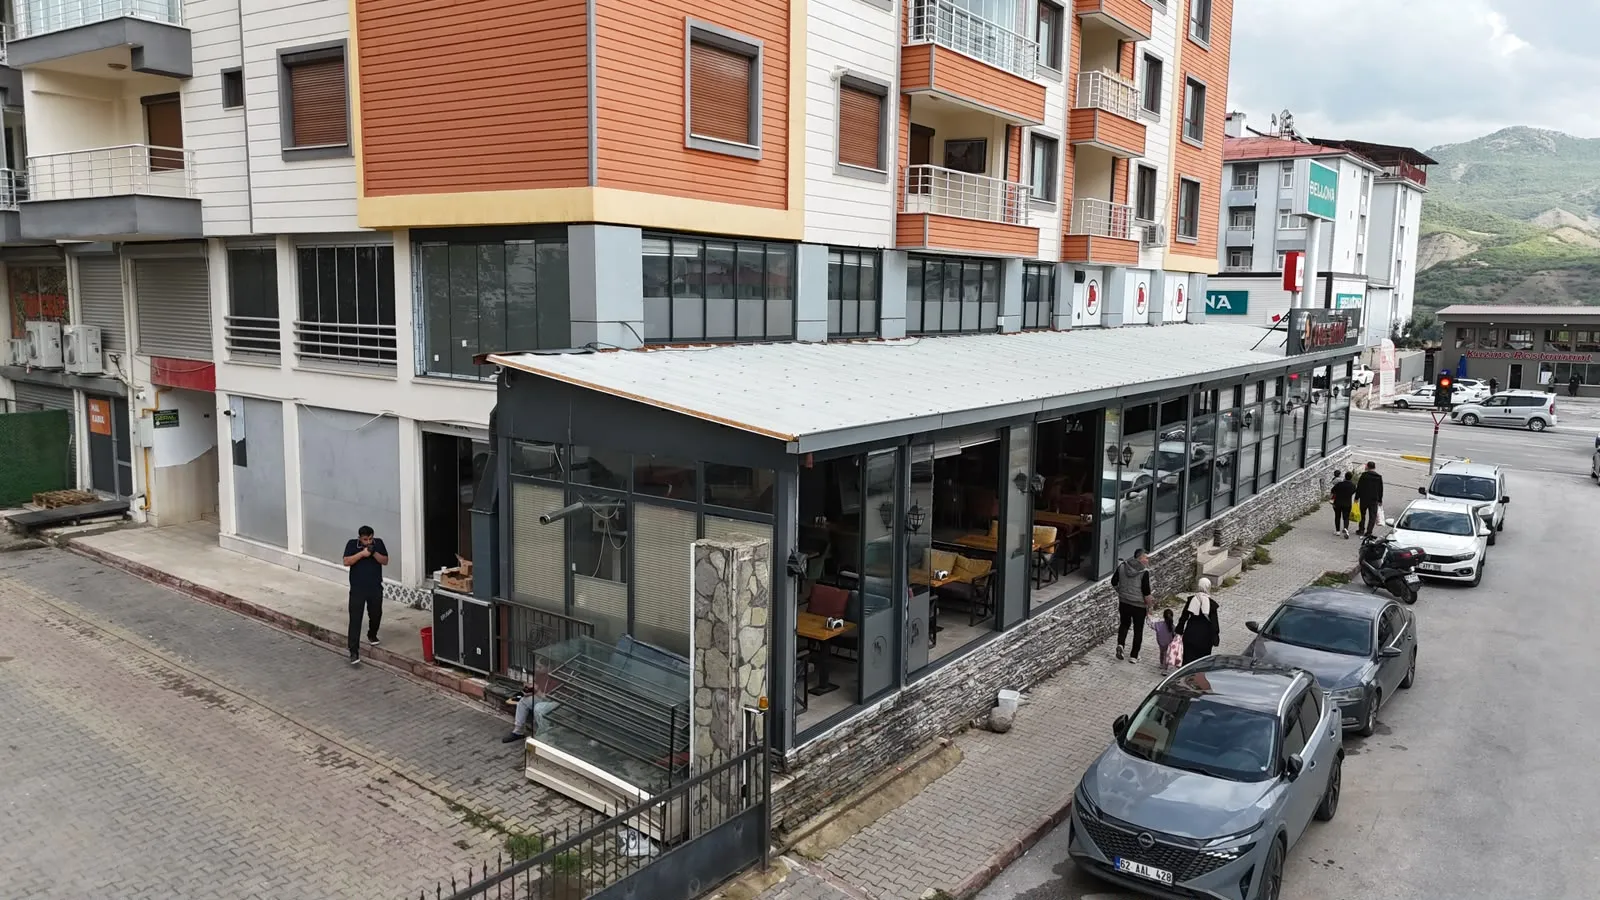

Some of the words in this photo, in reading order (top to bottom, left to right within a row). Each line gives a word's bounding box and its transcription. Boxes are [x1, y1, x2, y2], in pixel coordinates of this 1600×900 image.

[1310, 180, 1335, 202] BELLONA
[1513, 351, 1593, 361] Restaurant
[1120, 860, 1130, 870] 62
[1136, 864, 1150, 876] AAL
[1156, 870, 1171, 882] 428
